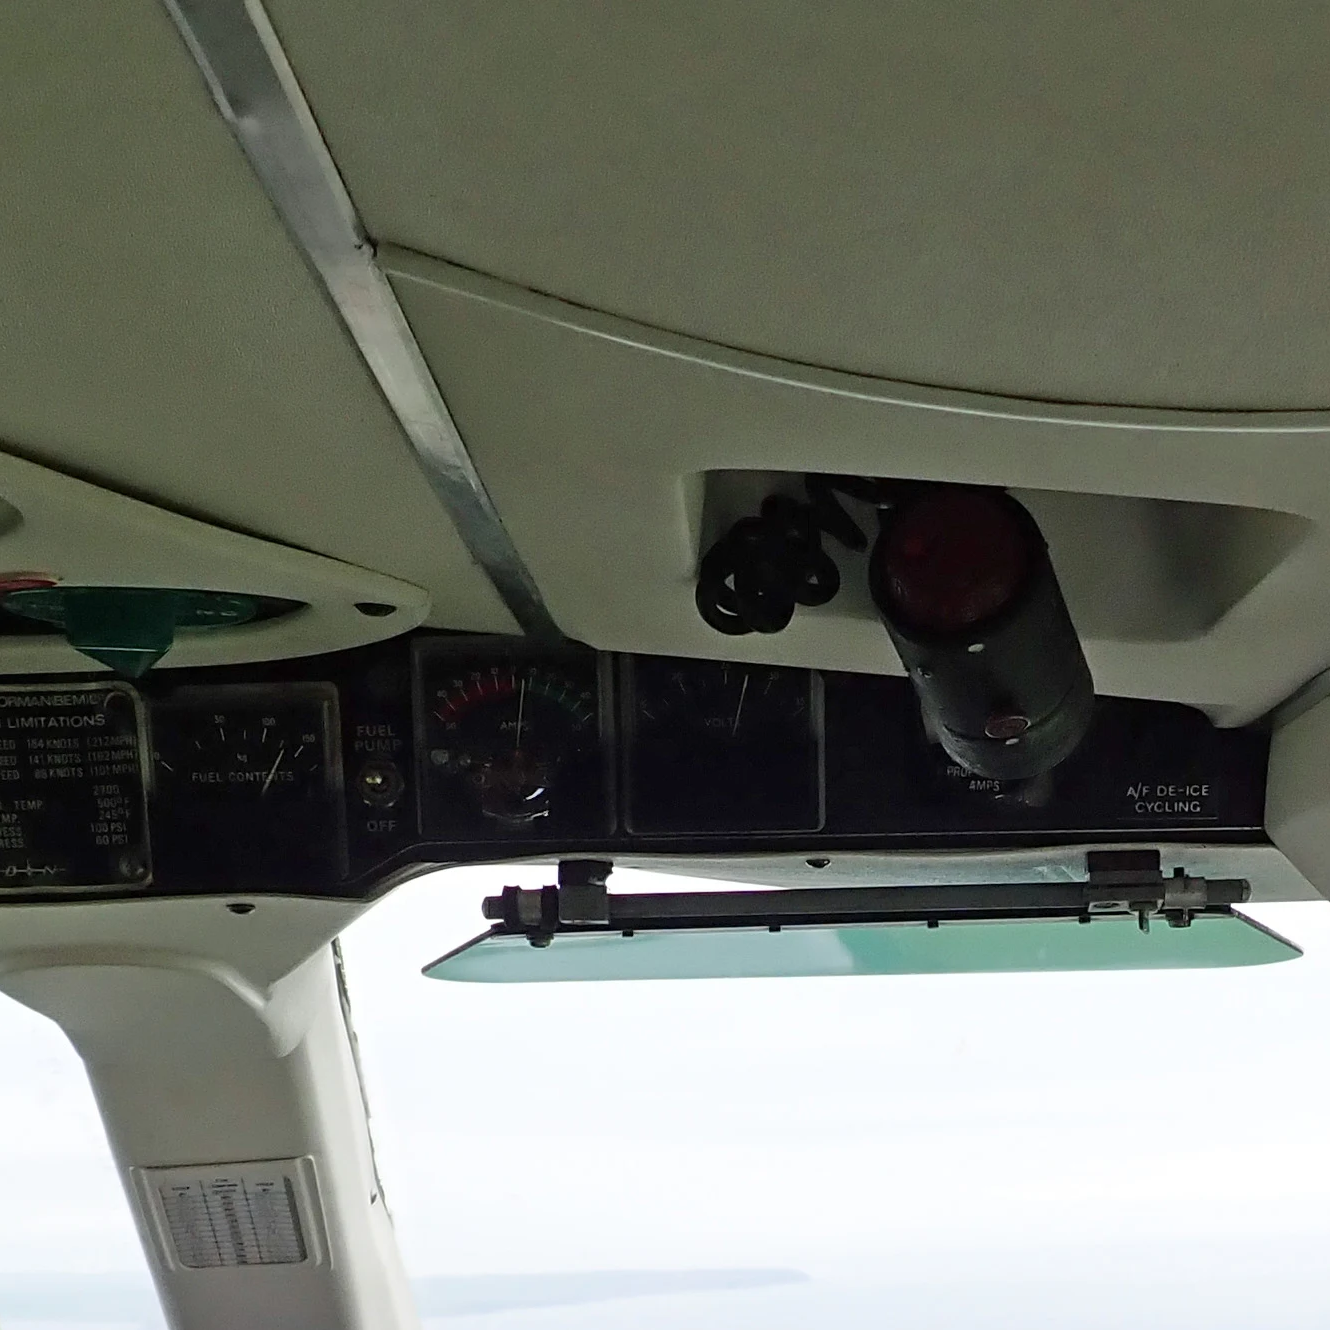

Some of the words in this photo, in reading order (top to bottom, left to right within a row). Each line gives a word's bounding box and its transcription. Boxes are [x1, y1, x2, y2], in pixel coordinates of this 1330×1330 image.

[7, 713, 106, 729] LIMITATIONS
[356, 724, 396, 737] FUEL
[354, 739, 403, 752] PUMP
[191, 771, 222, 783] FUEL
[969, 780, 1000, 792] AMPS
[1126, 781, 1151, 798] A/F
[1156, 784, 1210, 797] DE-ICE
[1134, 801, 1202, 813] CYCLING
[366, 820, 397, 832] OFF
